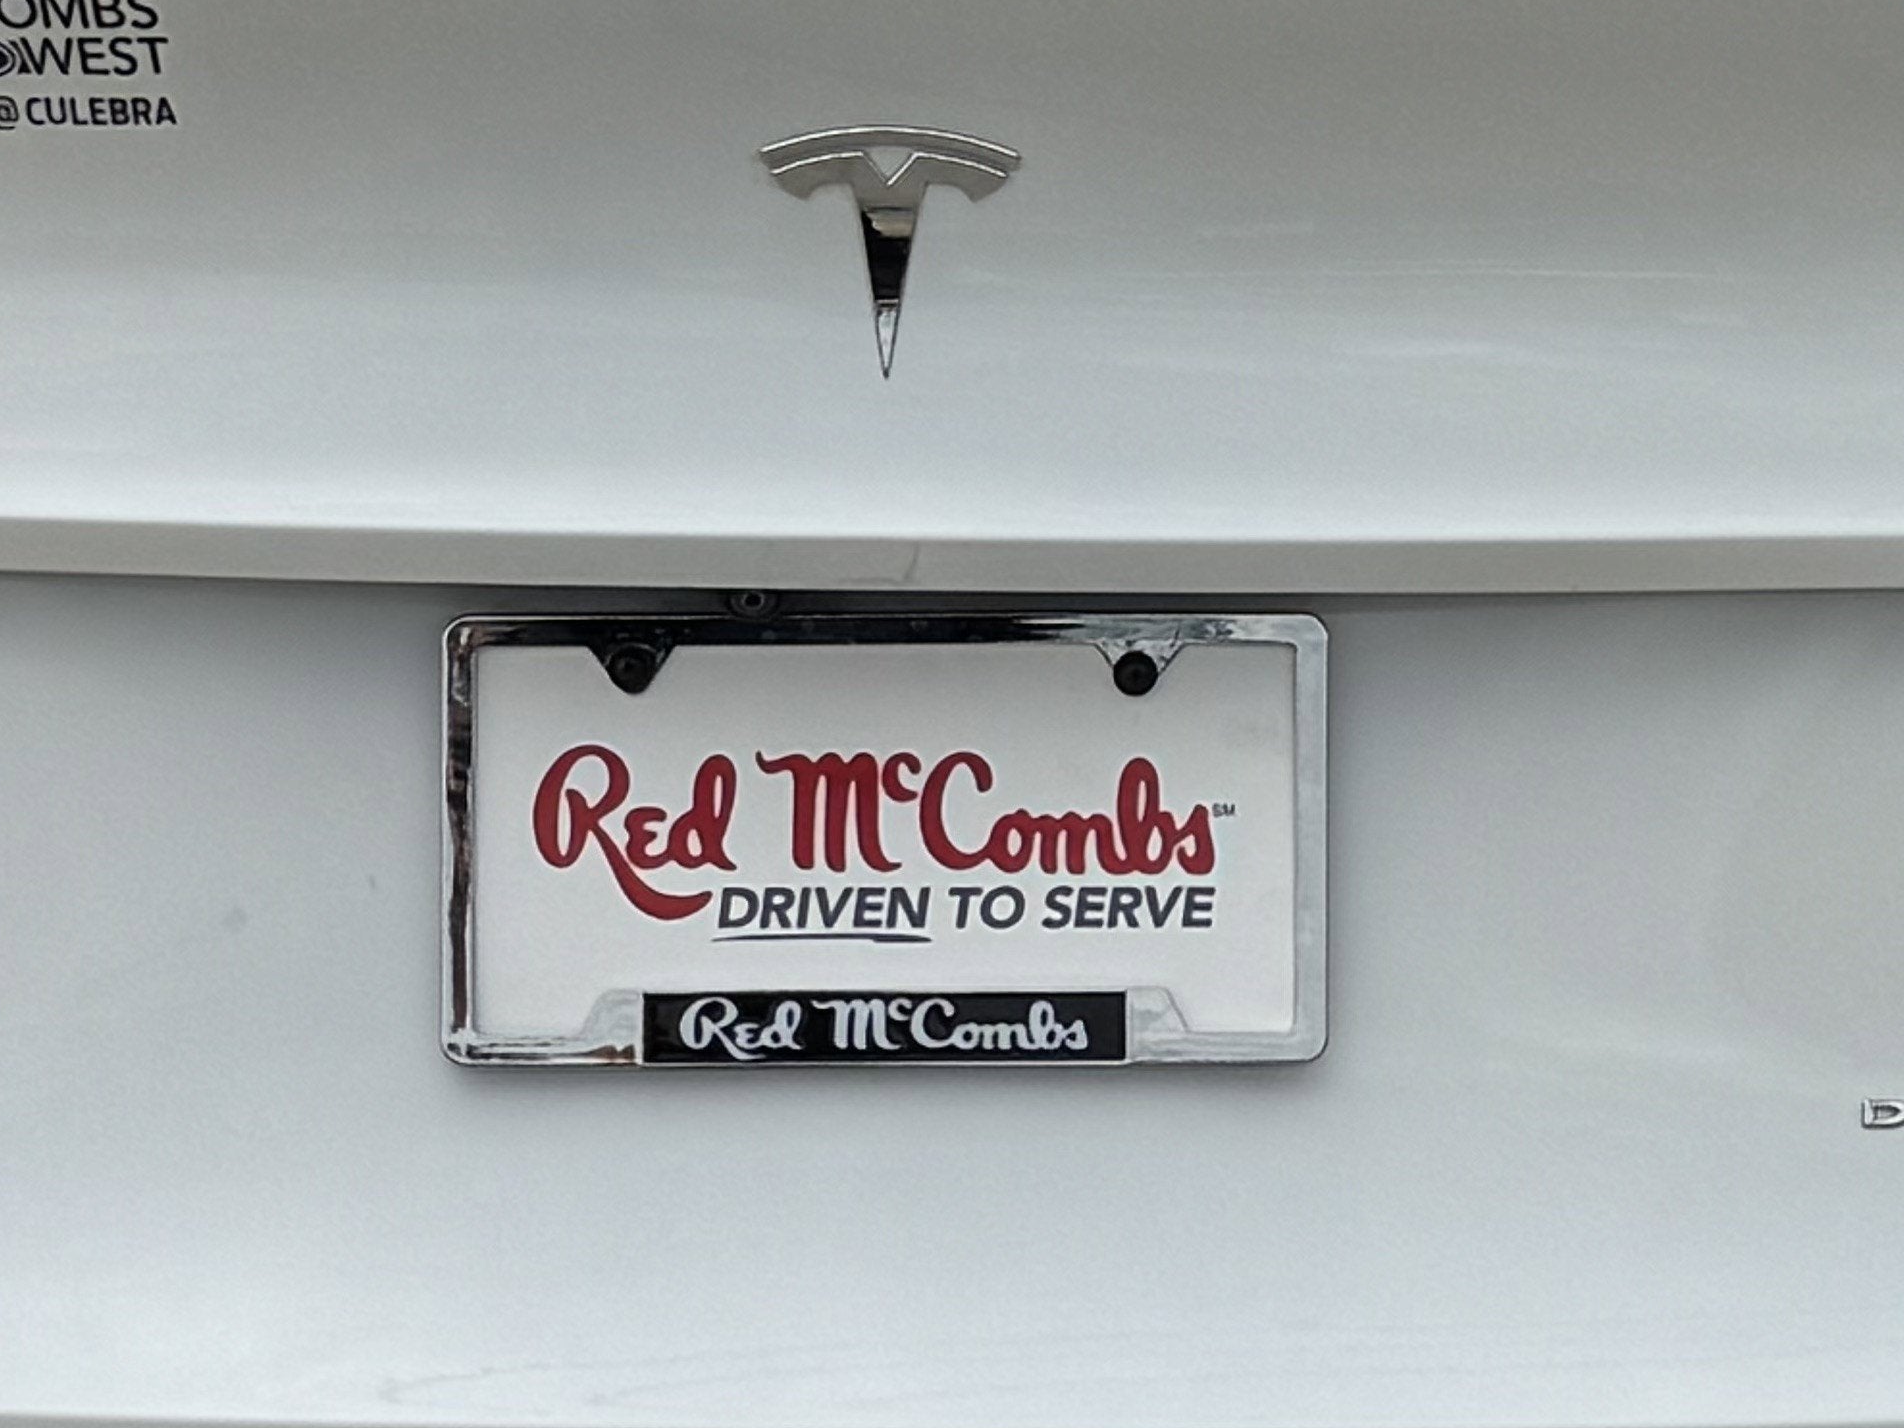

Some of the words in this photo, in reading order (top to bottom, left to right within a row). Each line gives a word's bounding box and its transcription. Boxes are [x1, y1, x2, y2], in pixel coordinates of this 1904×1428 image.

[22, 36, 169, 76] WEST
[25, 96, 177, 126] CULEBRA
[532, 743, 739, 922] Red
[755, 749, 1217, 876] McCombs
[717, 885, 931, 931] DRIVEN
[948, 885, 1028, 931] TO
[1040, 885, 1217, 930] SERVE
[679, 995, 801, 1060] Red
[811, 997, 1089, 1052] McCombs
